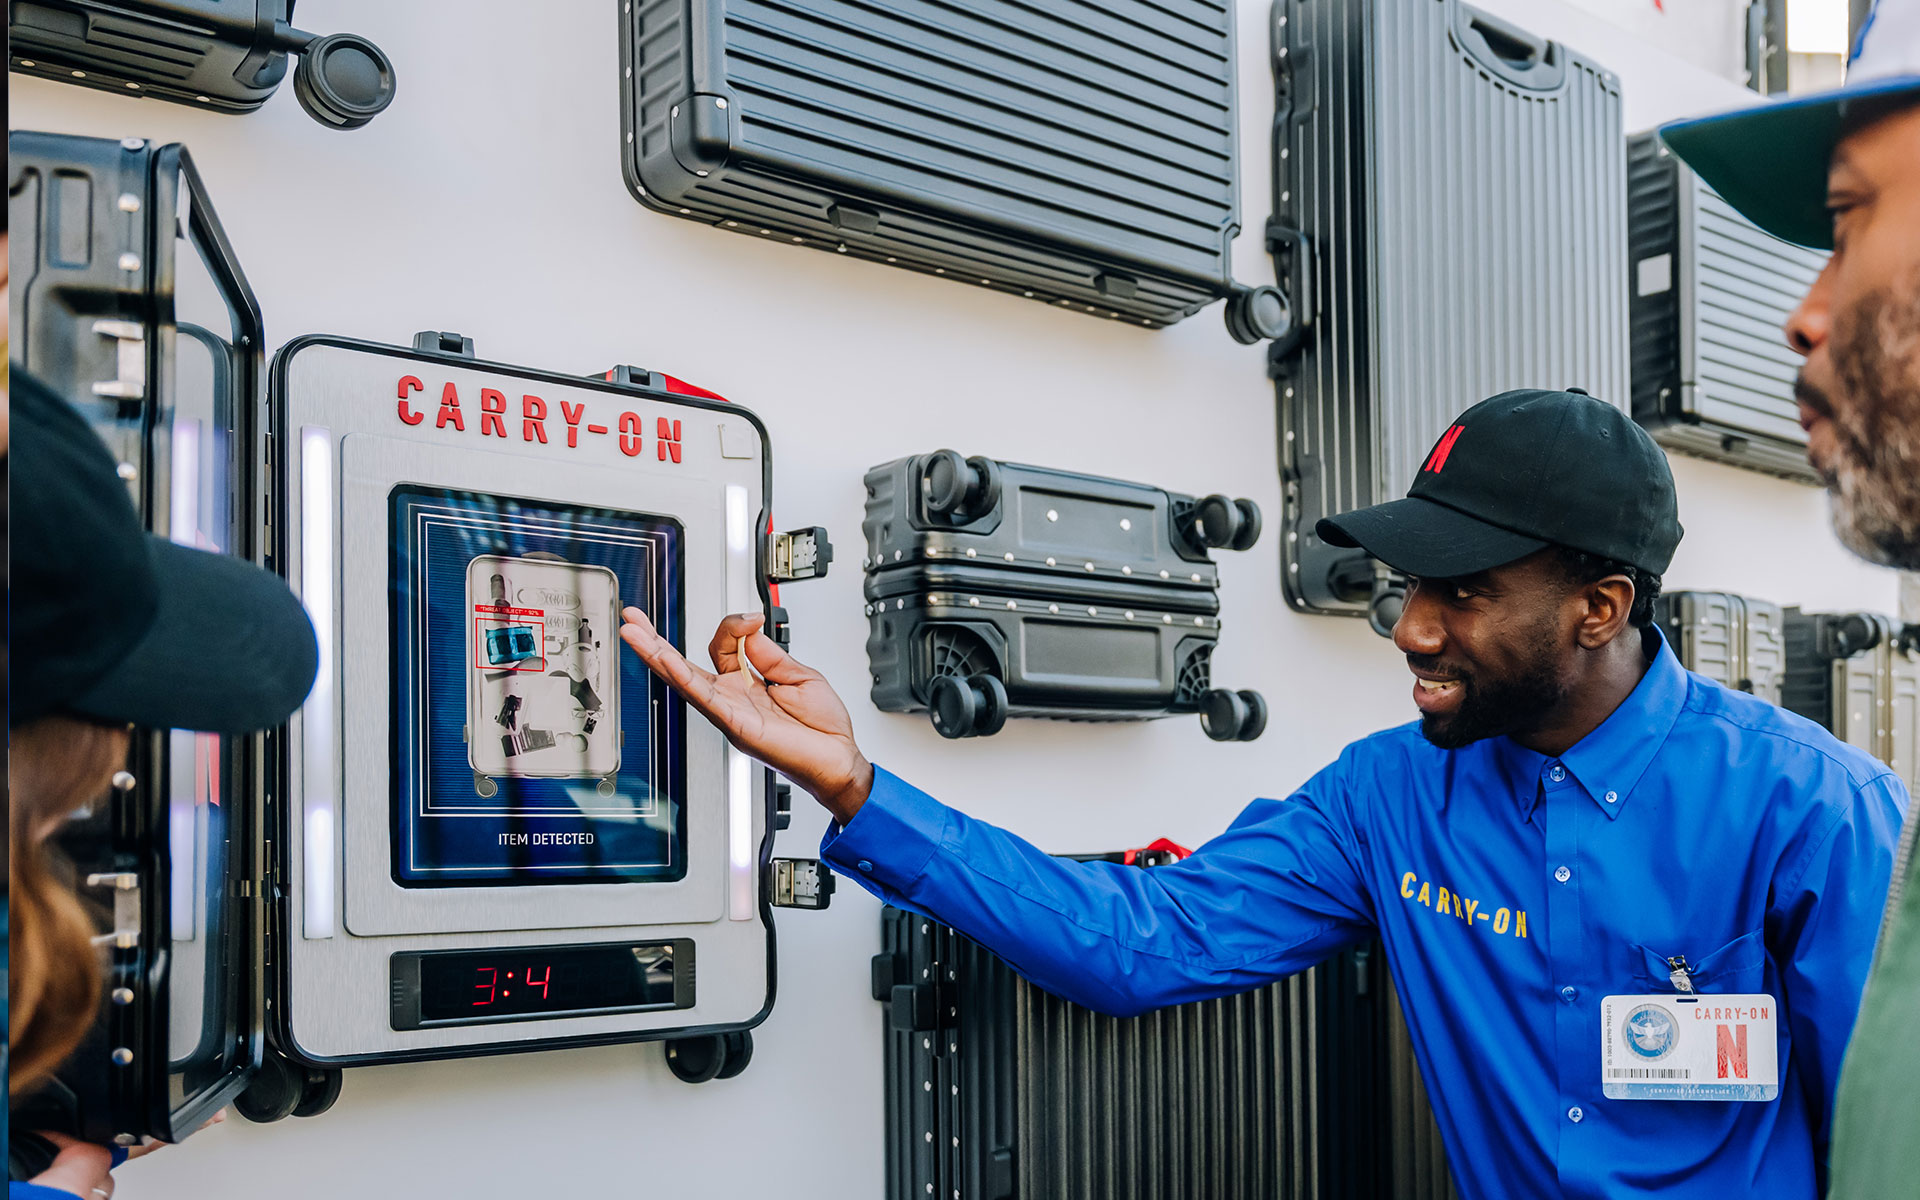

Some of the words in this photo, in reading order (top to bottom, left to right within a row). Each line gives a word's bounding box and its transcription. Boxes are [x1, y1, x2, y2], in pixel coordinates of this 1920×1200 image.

[398, 375, 682, 463] CARRY-ON
[1424, 424, 1466, 474] N
[498, 833, 528, 845] ITEM
[532, 833, 594, 845] DETECTED
[1401, 872, 1527, 938] CARRY-ON
[1695, 1007, 1768, 1020] CARRY-ON
[1716, 1024, 1748, 1079] N
